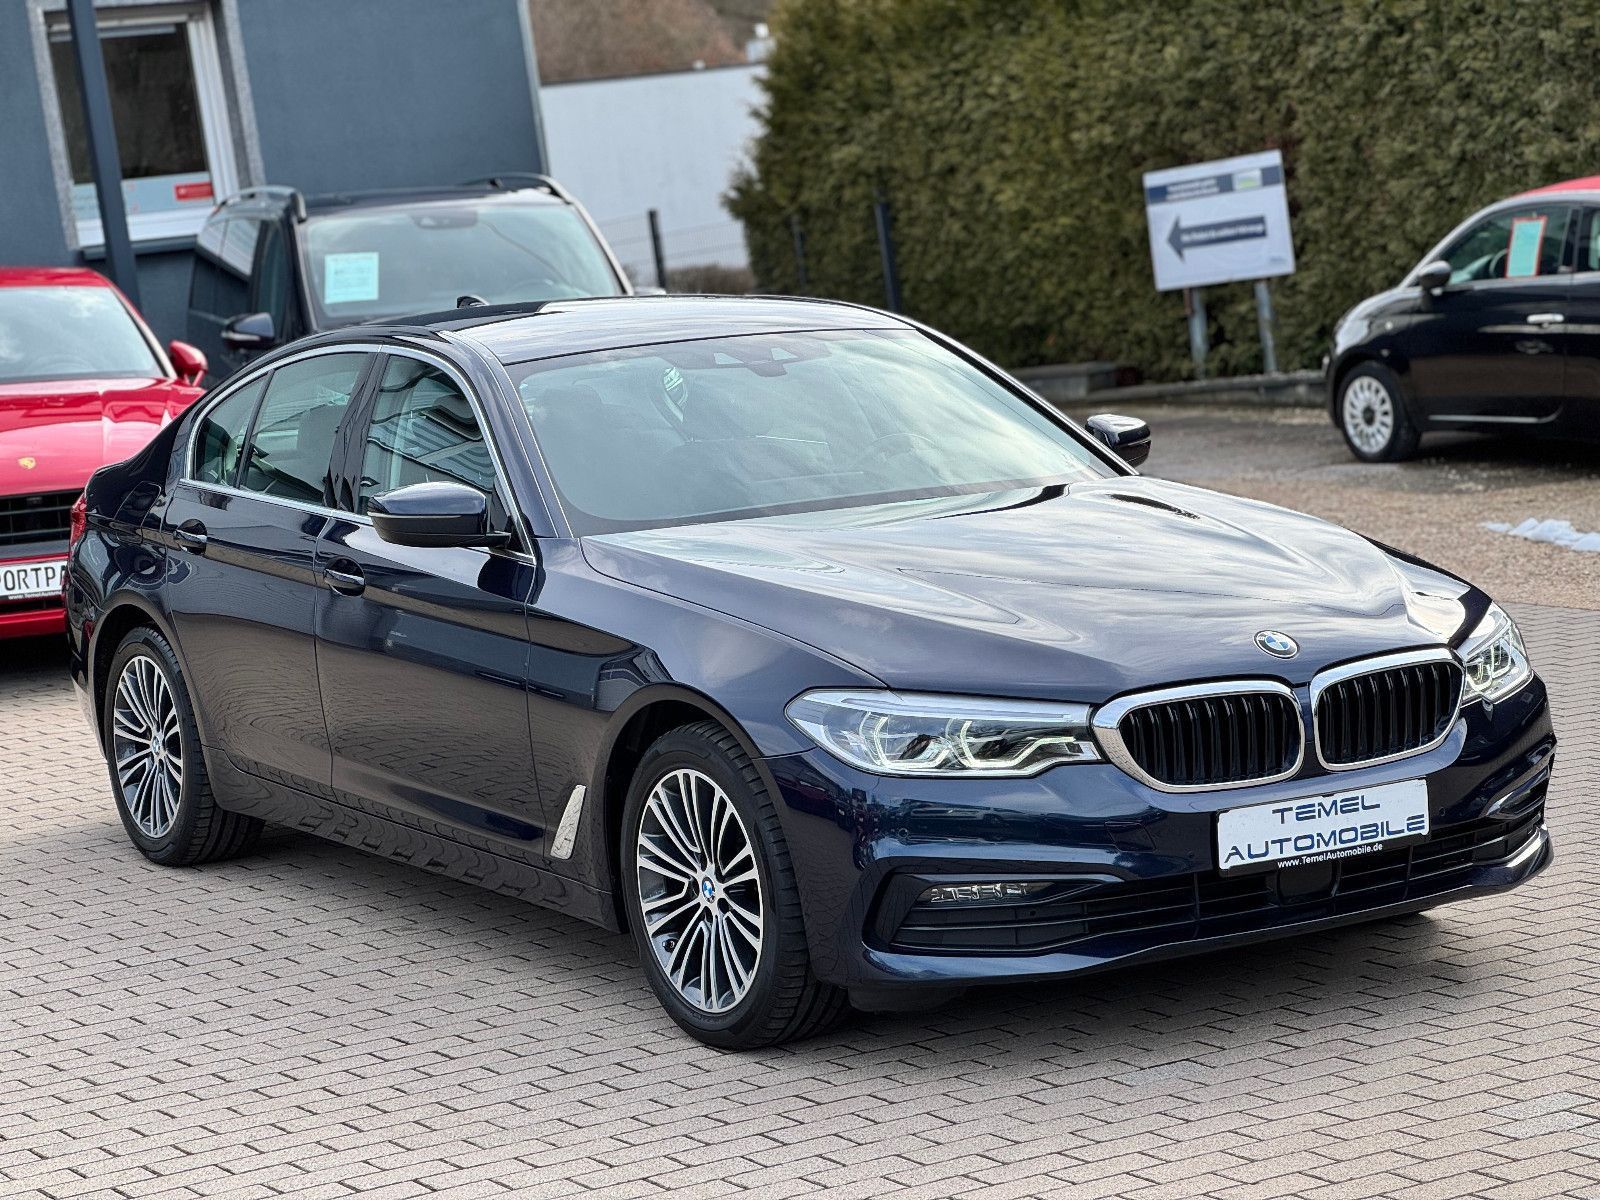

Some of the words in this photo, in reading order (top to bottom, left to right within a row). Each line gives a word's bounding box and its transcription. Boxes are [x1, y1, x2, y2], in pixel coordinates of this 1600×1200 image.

[0, 565, 66, 591] ORTP
[1272, 795, 1381, 824] TEMEL
[1224, 814, 1425, 863] AUTOMOBILE
[1277, 842, 1383, 869] www.TemelAutomobile.de
